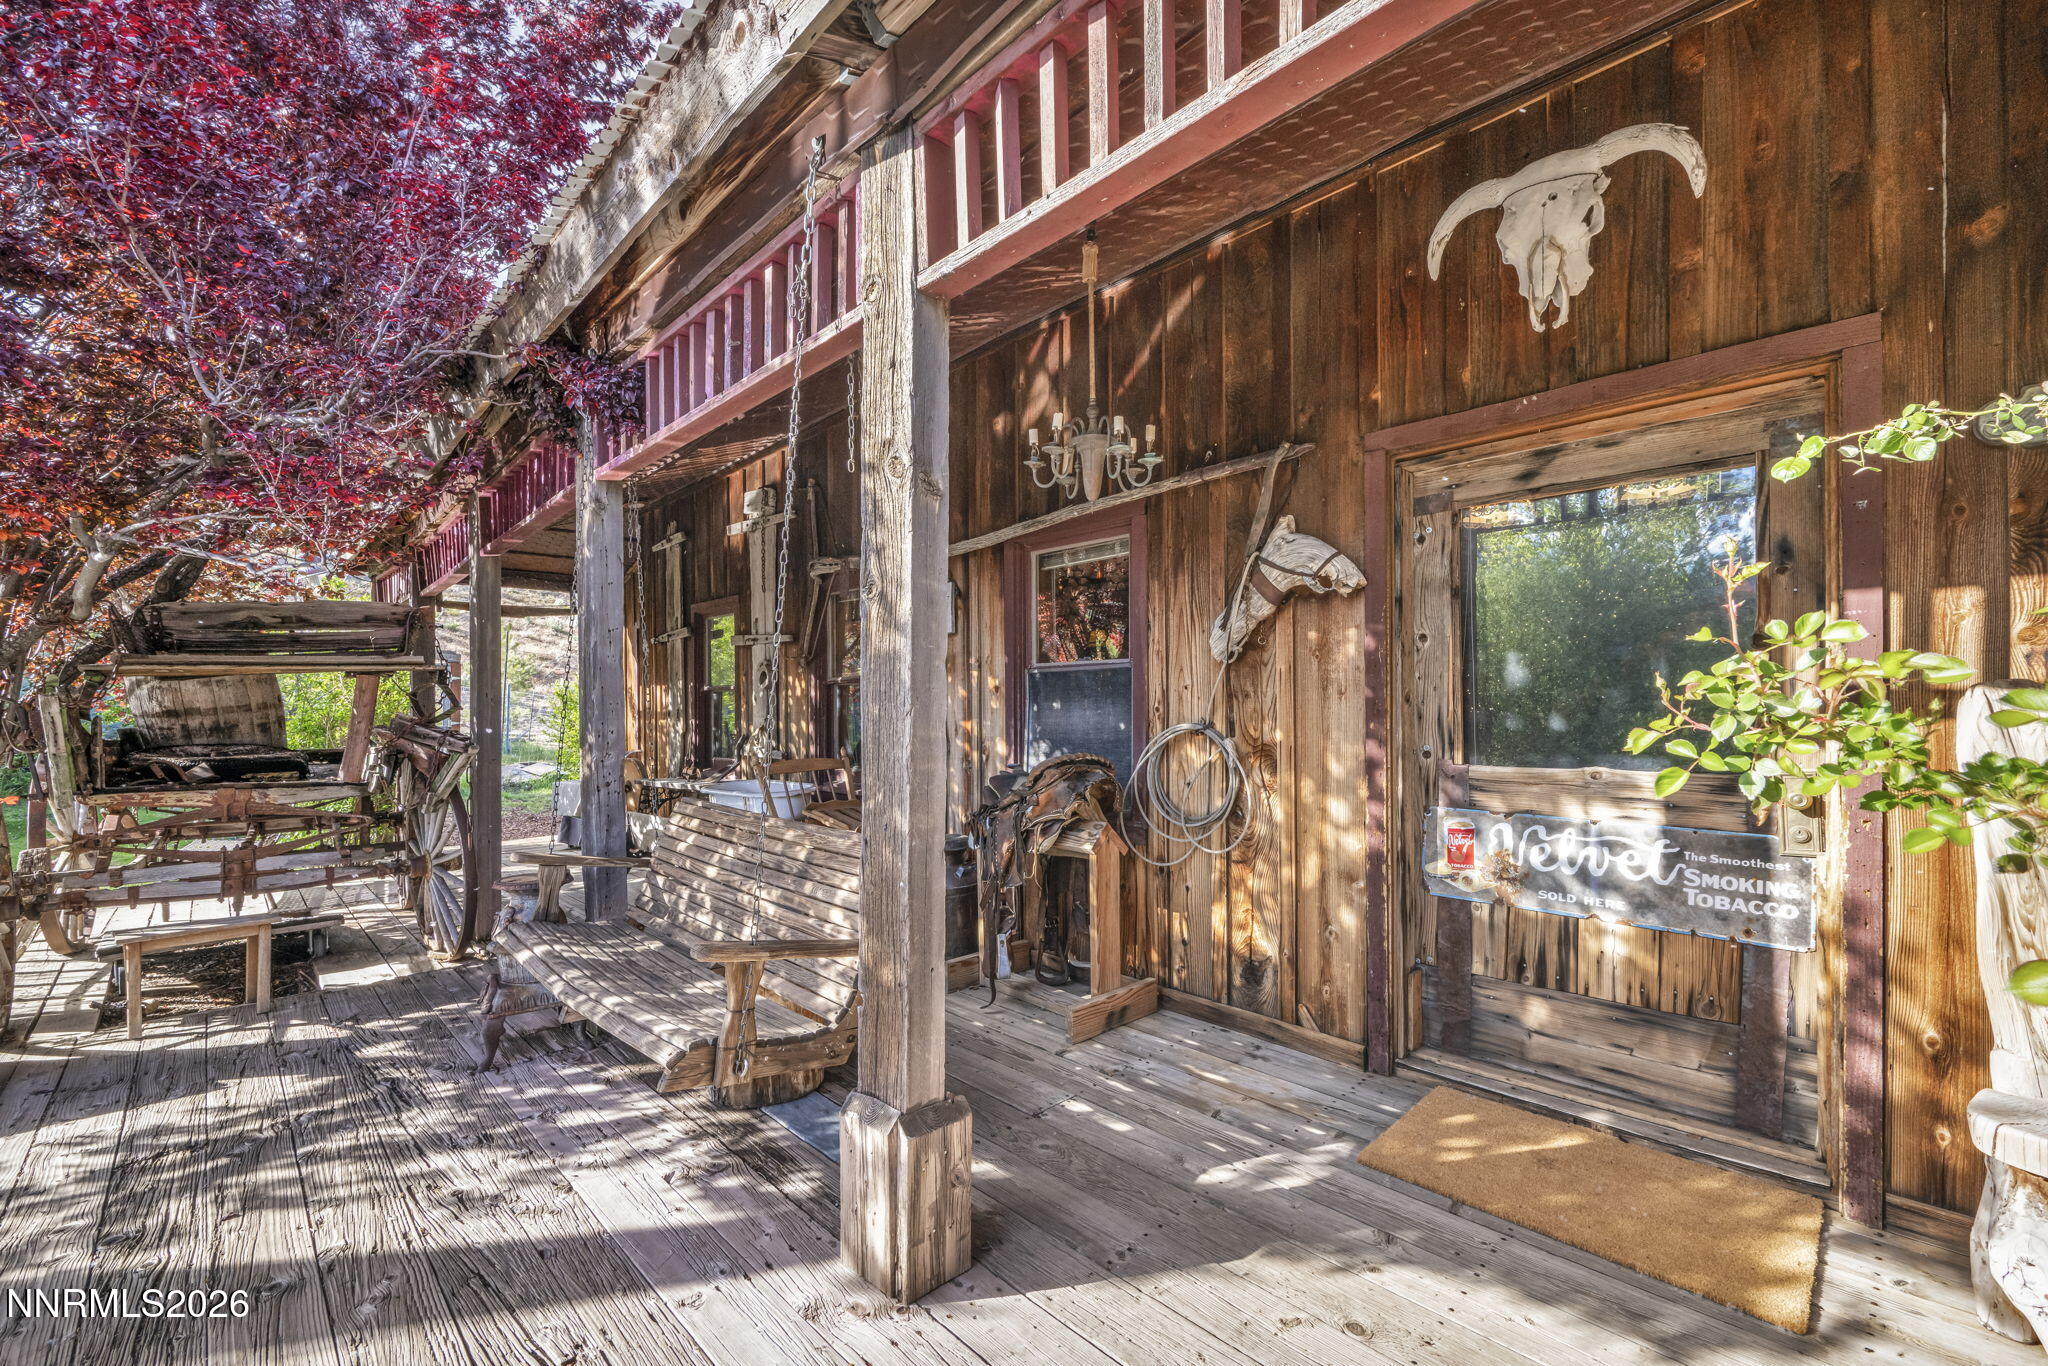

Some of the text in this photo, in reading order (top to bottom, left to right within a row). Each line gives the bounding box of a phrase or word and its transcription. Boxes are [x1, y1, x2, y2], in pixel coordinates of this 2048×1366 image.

[1488, 822, 1685, 886] Velvet
[1683, 851, 1792, 872] The Smoothest
[1683, 868, 1802, 899] SMOKING
[1537, 890, 1627, 911] SOLD HERE
[1682, 887, 1800, 920] TOBACCO
